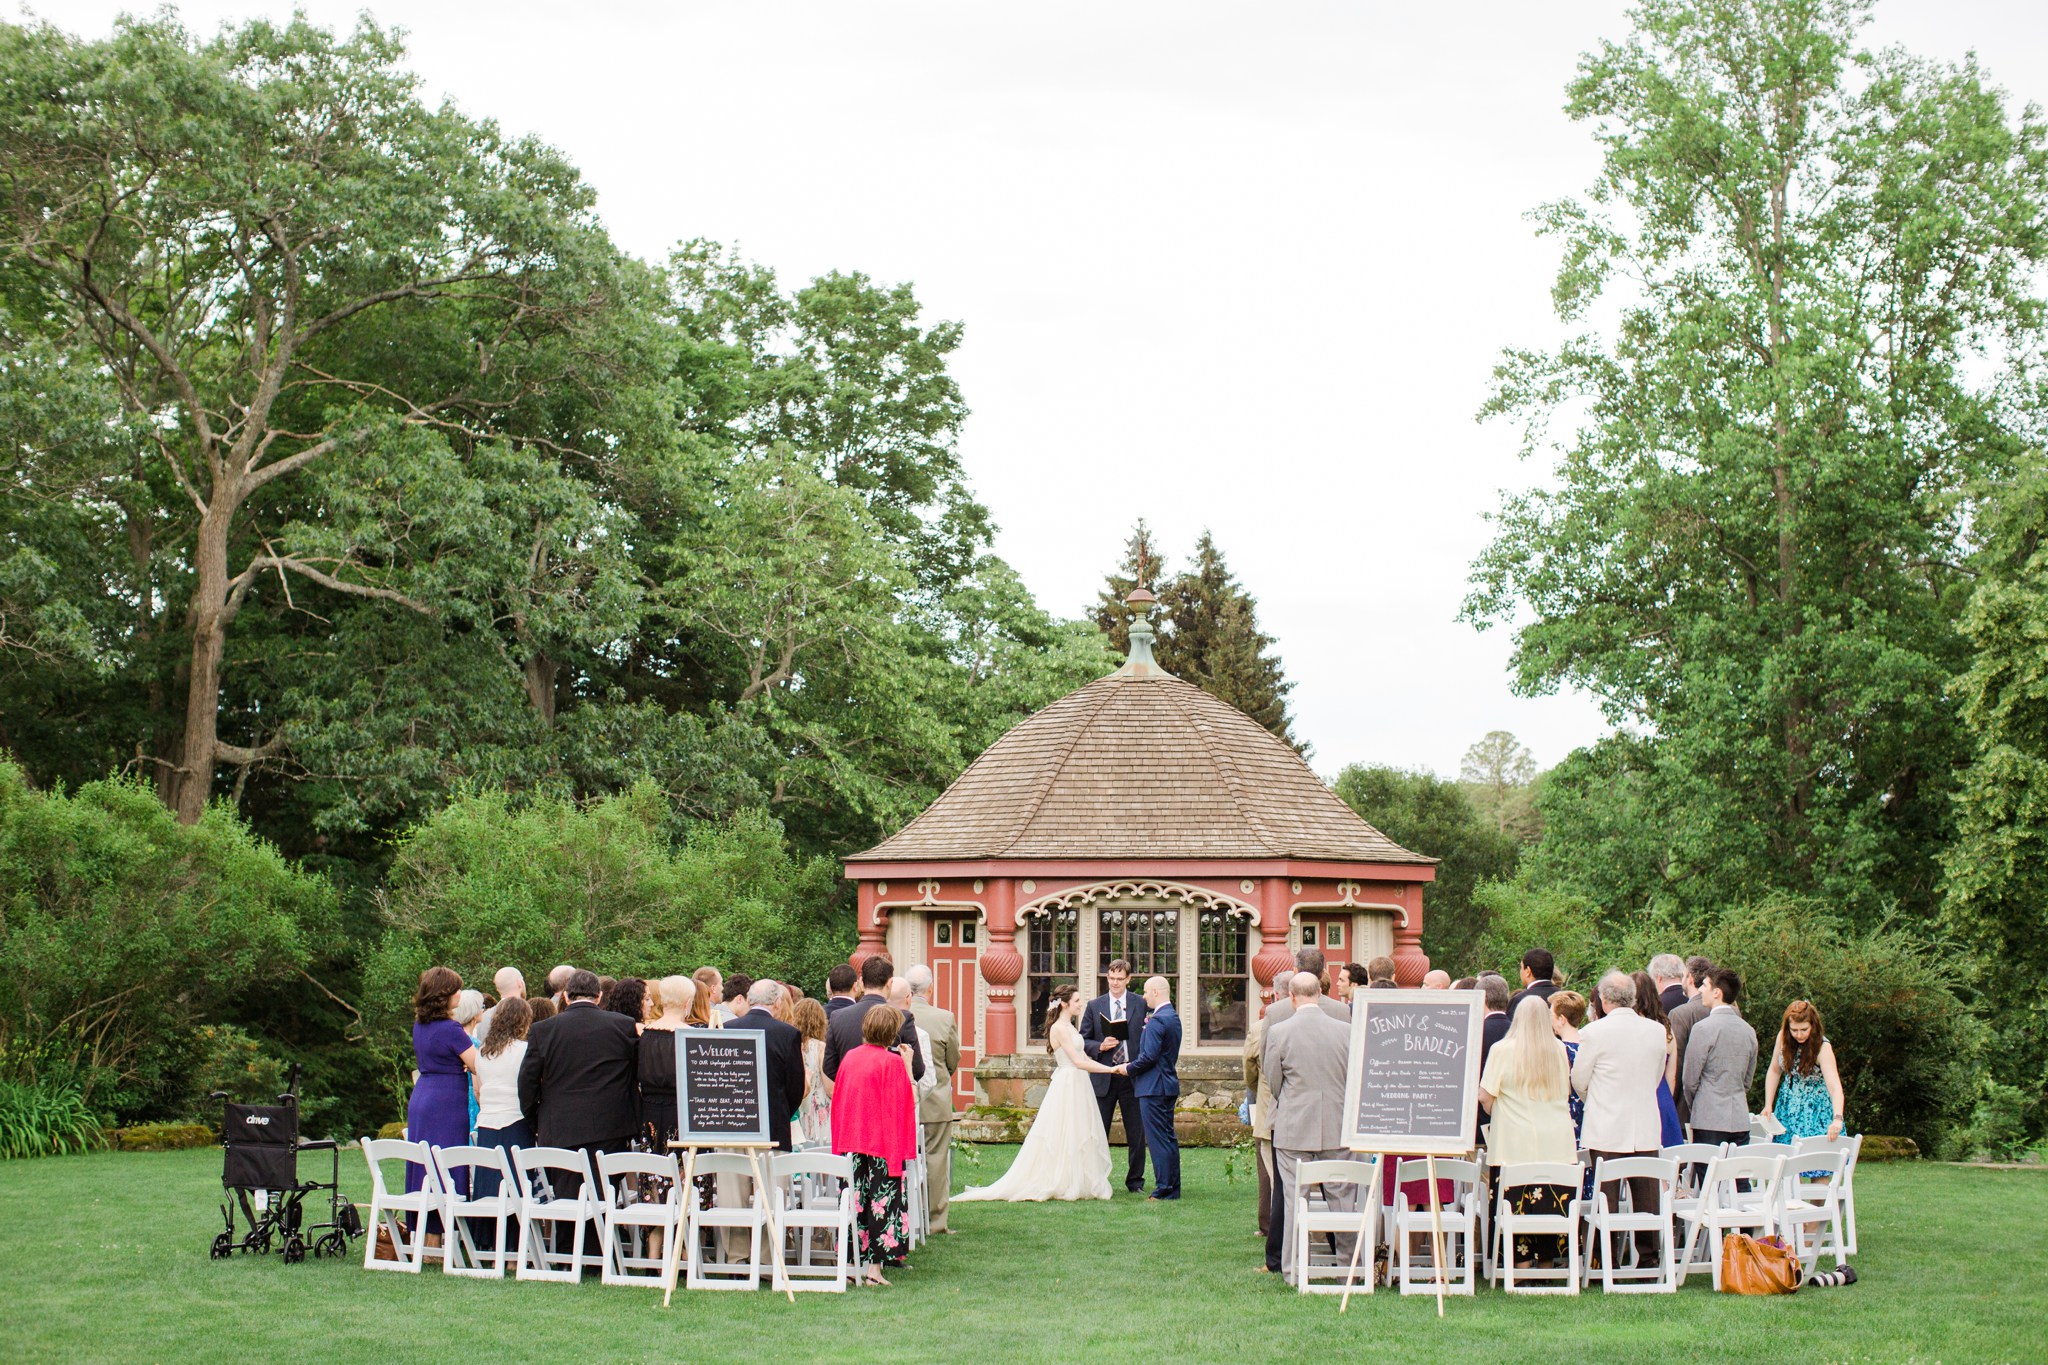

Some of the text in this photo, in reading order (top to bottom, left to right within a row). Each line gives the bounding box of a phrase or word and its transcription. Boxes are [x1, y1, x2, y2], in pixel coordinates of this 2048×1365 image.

[1370, 1014, 1430, 1035] JENNY &
[699, 1044, 739, 1057] WELCOME
[1404, 1034, 1465, 1059] BRADLEY
[246, 1115, 269, 1125] drive
